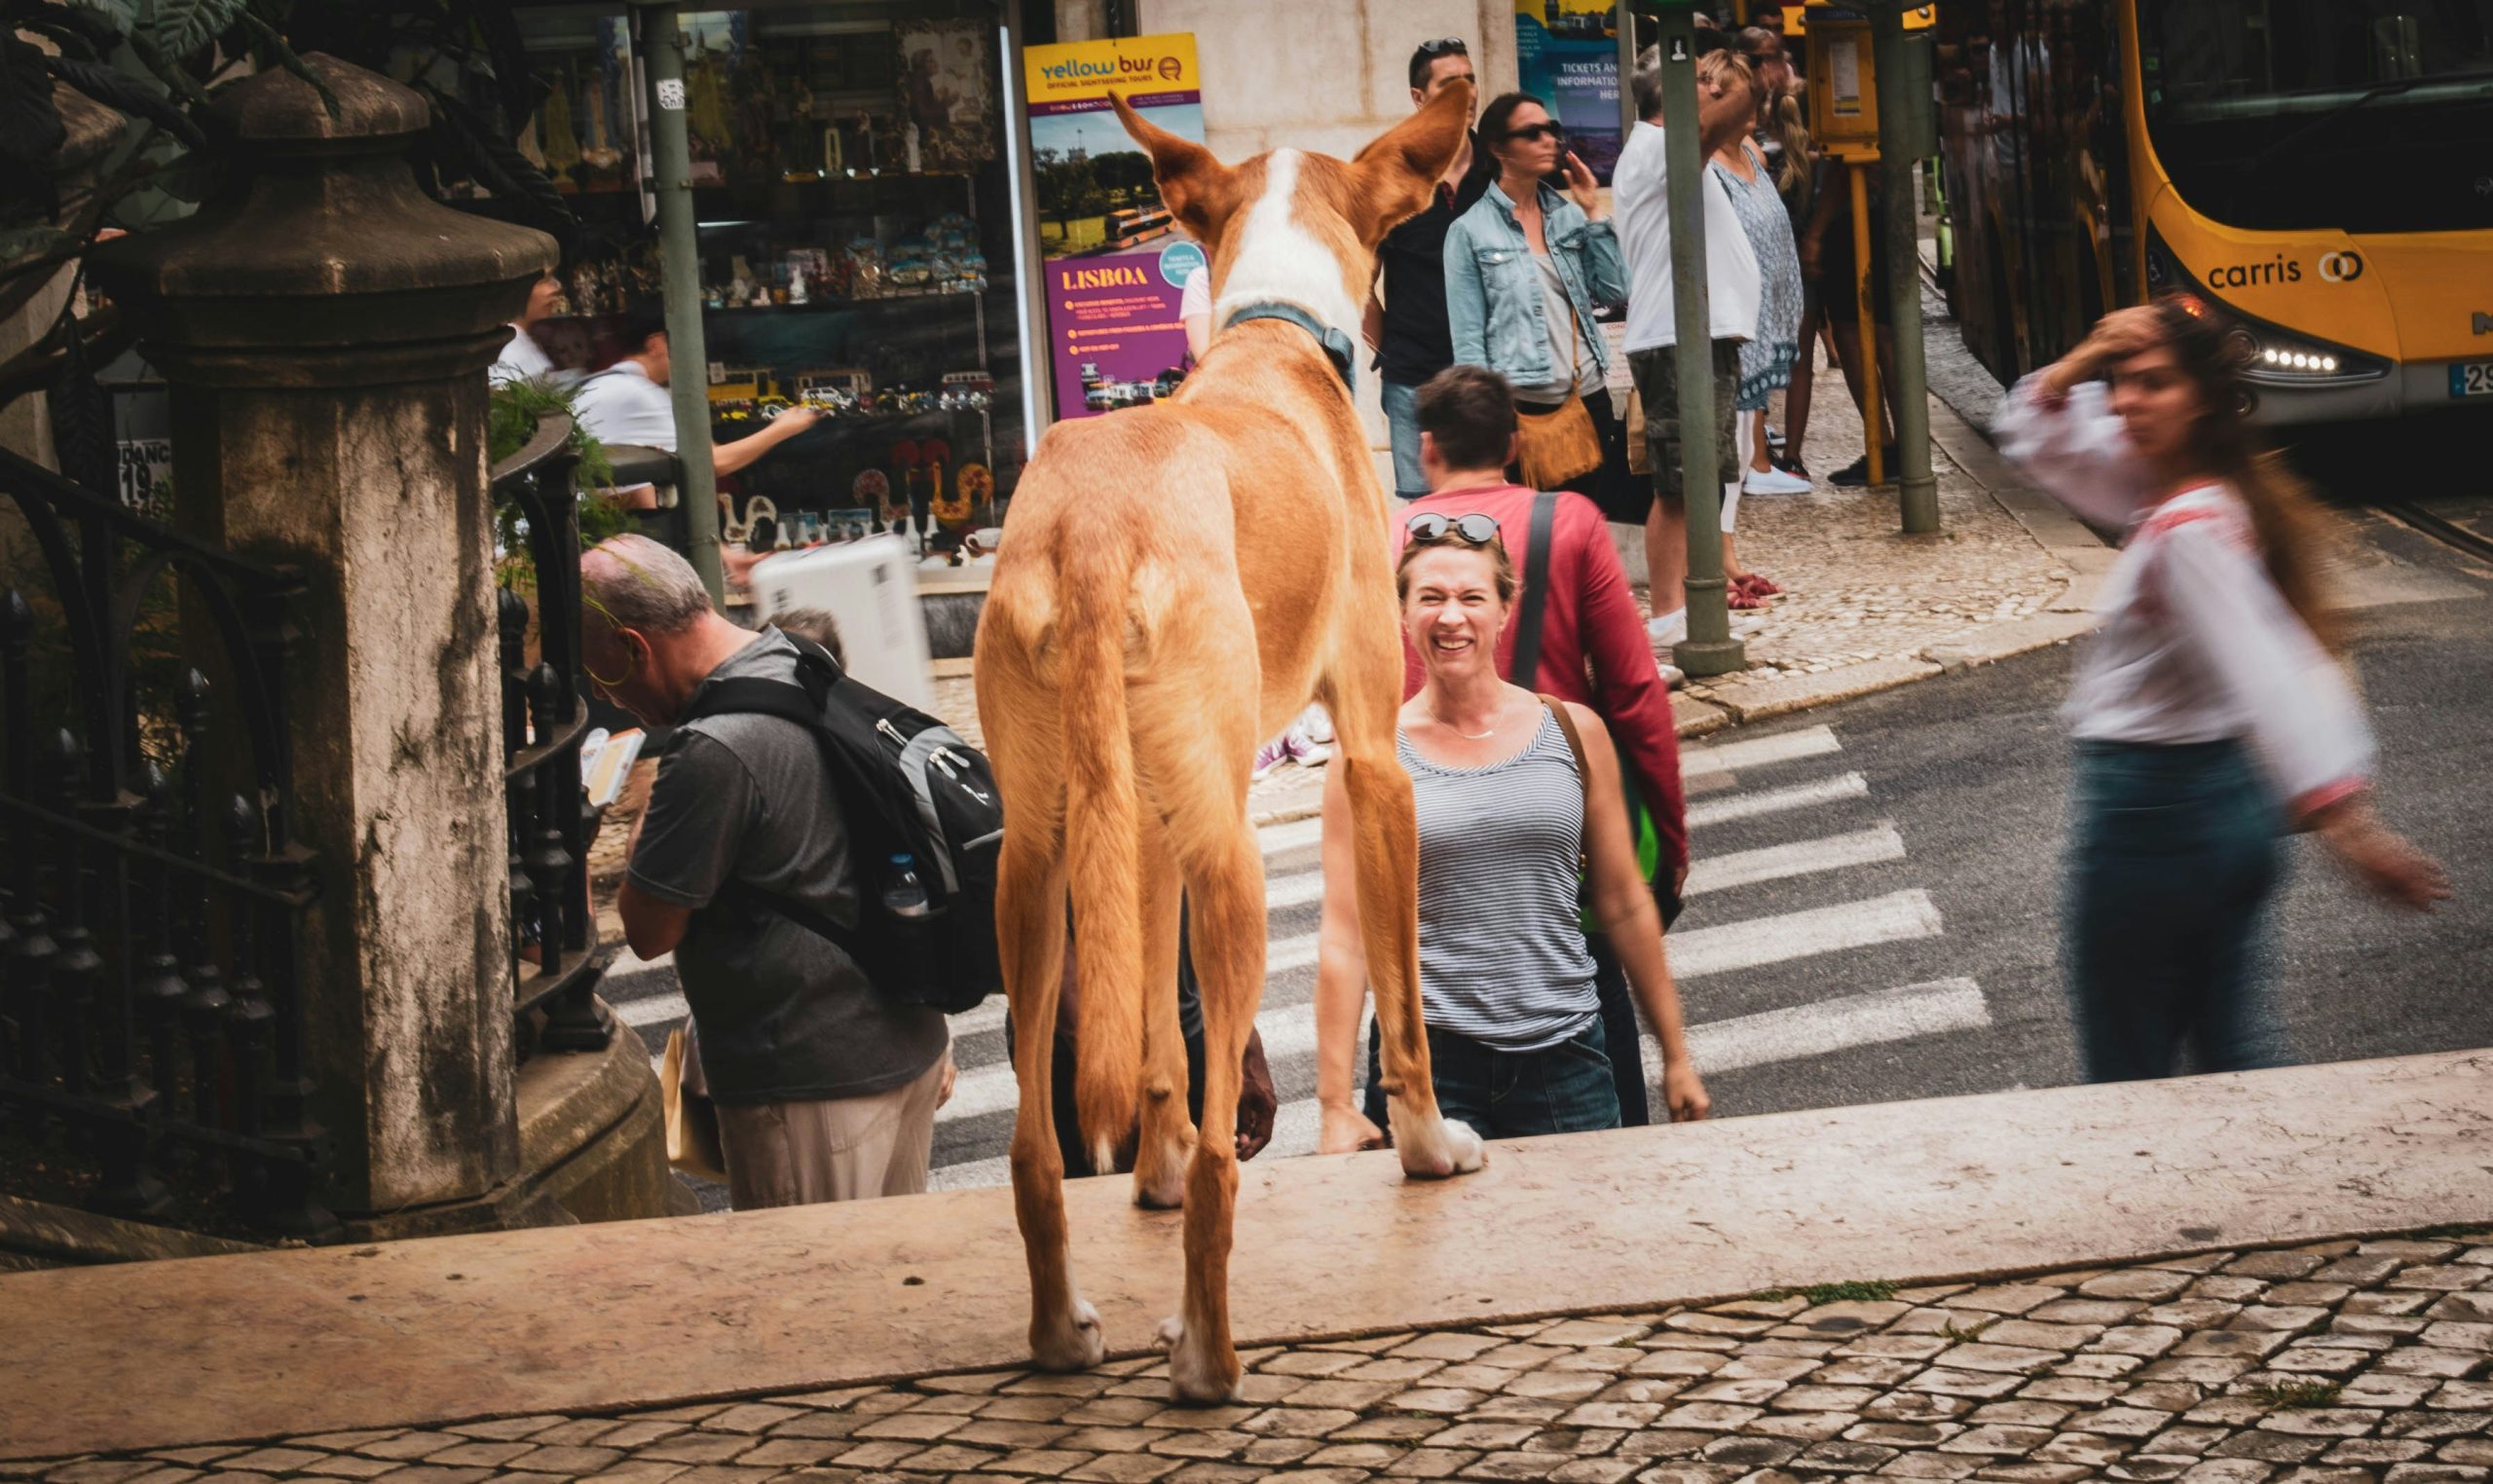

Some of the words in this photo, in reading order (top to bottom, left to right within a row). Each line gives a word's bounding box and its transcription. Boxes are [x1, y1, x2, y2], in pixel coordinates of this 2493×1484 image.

[1041, 59, 1115, 80] yellow
[1119, 55, 1154, 73] bus
[1562, 62, 1601, 73] TICKETS
[1047, 81, 1078, 91] OFFICIAL
[1080, 76, 1127, 88] SIGHTSEEING
[1129, 74, 1154, 84] TOURS
[1600, 90, 1619, 99] HER
[1061, 267, 1148, 291] LISBOA
[2209, 253, 2302, 289] carris
